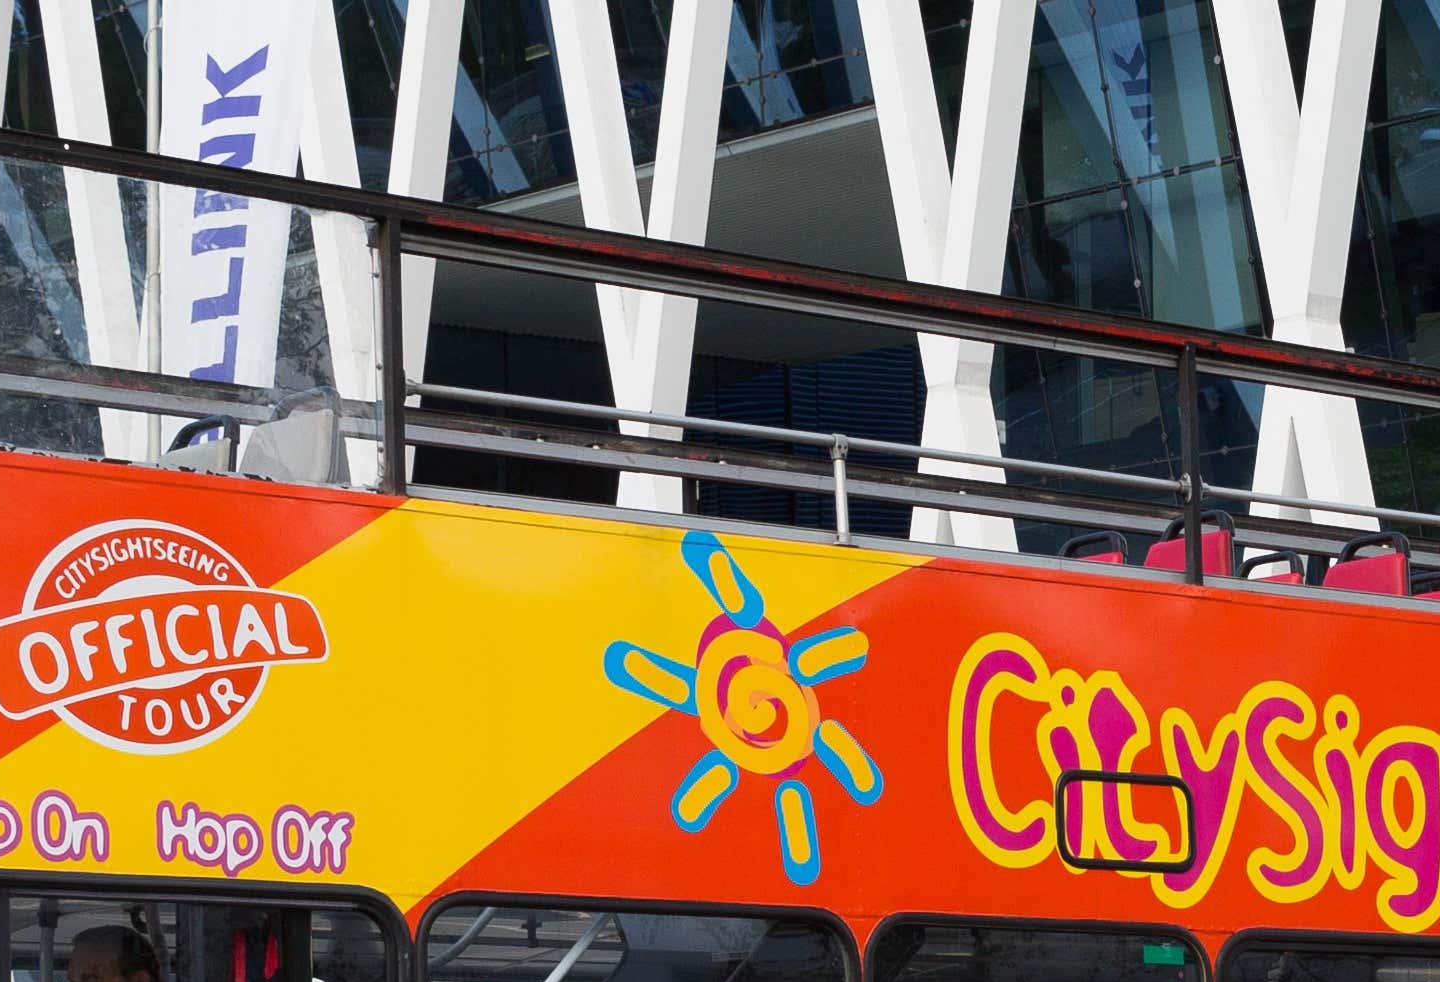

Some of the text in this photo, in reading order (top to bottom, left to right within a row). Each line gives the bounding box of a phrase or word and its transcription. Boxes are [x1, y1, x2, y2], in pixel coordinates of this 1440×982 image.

[188, 44, 270, 447] LLINK
[55, 535, 231, 600] CITYSIGHTSEEING
[17, 602, 310, 694] OFFICIAL
[117, 677, 247, 737] TOUR
[32, 789, 110, 862] On
[157, 802, 263, 877] Hop
[272, 804, 355, 874] Off
